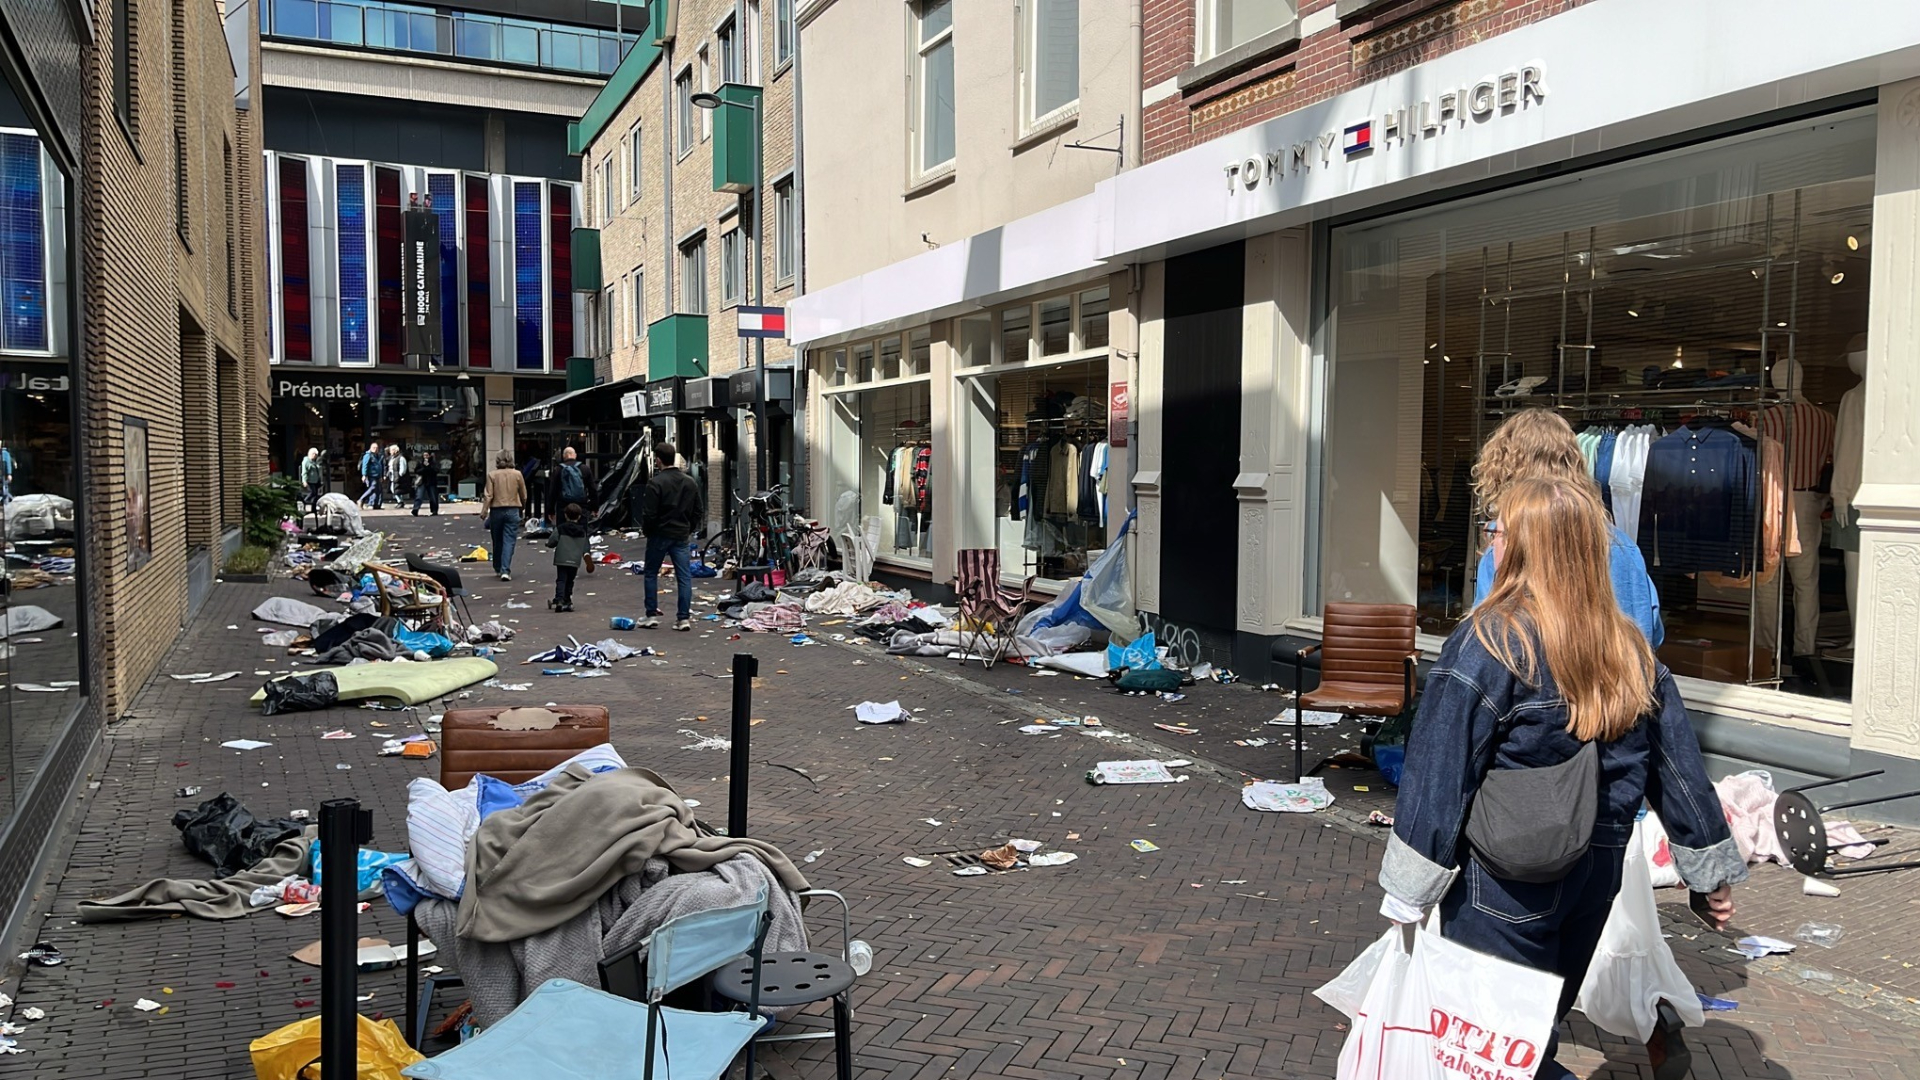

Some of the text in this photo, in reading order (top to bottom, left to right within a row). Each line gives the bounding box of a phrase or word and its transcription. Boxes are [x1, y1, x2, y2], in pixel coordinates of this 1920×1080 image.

[1224, 66, 1546, 192] TOMMY HILFIGER
[416, 241, 425, 289] CATHARIJNE
[417, 290, 425, 313] HOOG
[279, 380, 362, 399] Prénatal
